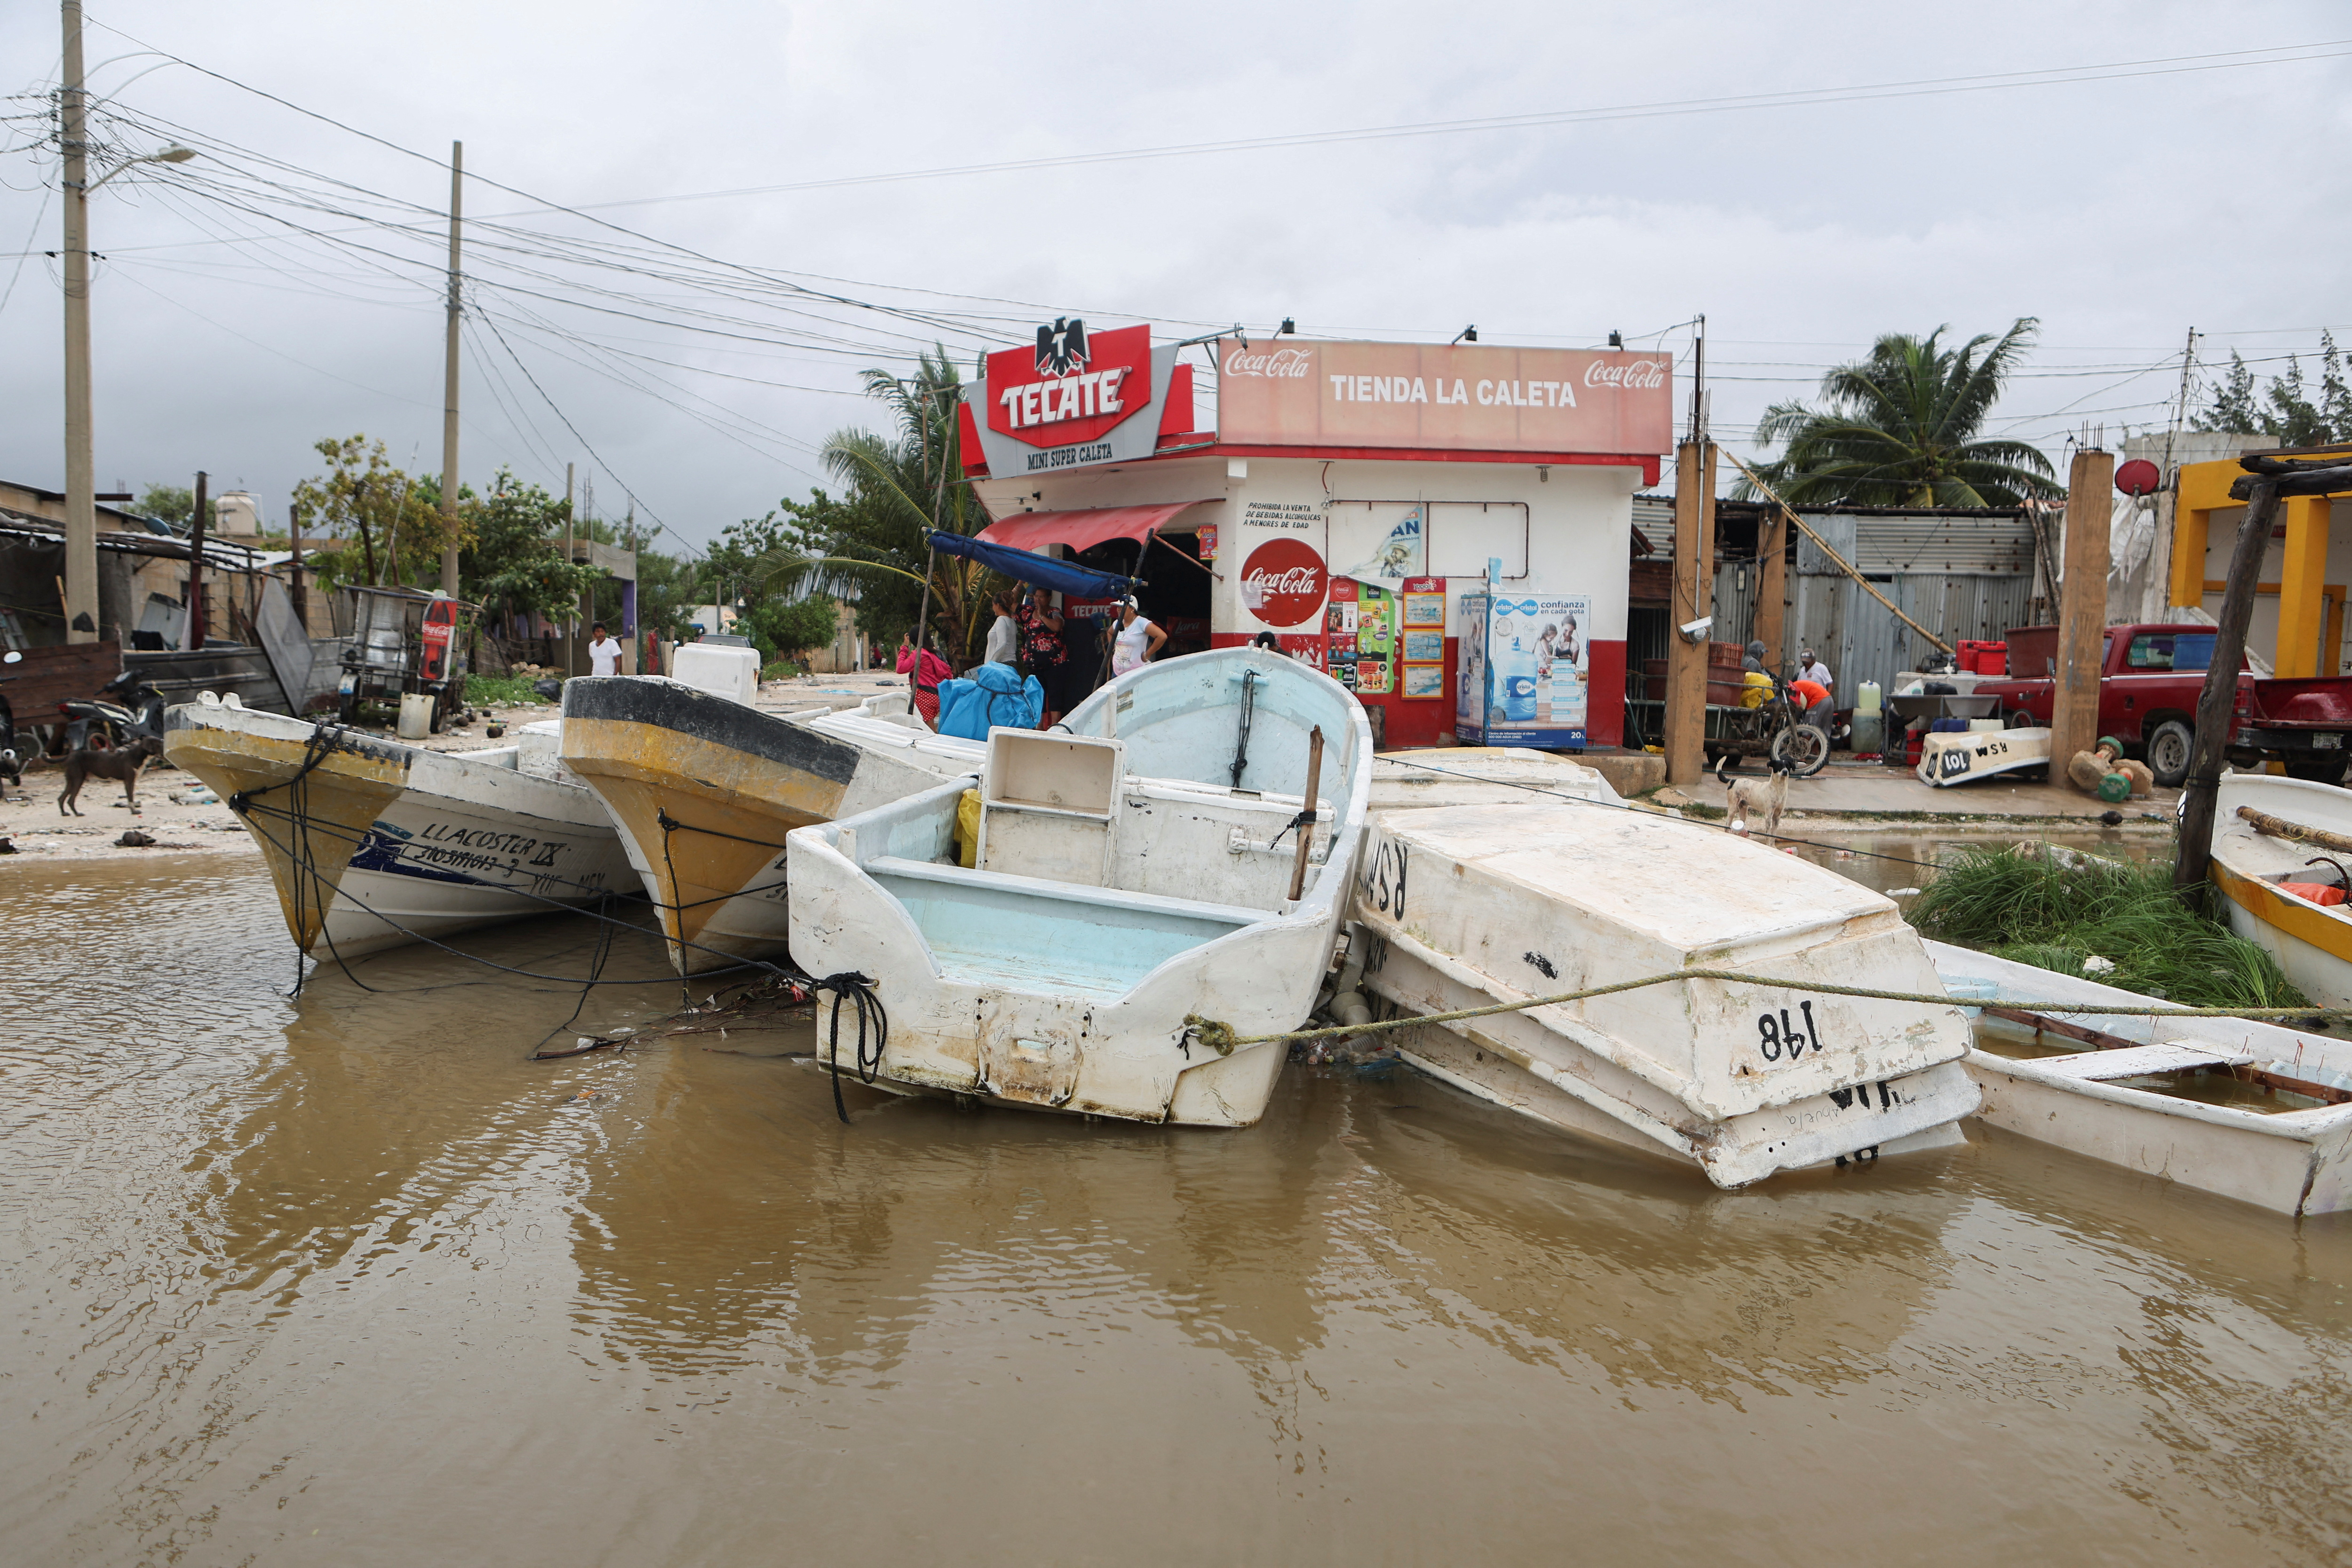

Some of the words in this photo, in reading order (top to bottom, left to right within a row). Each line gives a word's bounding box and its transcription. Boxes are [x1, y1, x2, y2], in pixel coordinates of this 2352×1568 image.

[1000, 368, 1122, 428] TECATE
[1330, 375, 1428, 402] TIENDA
[1436, 378, 1469, 404] LA
[1476, 379, 1577, 407] CALETA
[1027, 451, 1048, 470] MINI
[1051, 447, 1076, 467] SUPER
[1079, 443, 1112, 462] CALETA
[1248, 502, 1281, 511] PROHIBIDA
[1285, 513, 1321, 521] ALCOHOLICAS
[1249, 519, 1279, 528] MENORES
[1247, 567, 1319, 594] Coca-Cola
[1072, 605, 1112, 617] TECATE
[1945, 752, 1966, 771] 101
[1976, 742, 2008, 757] RSM
[1758, 1000, 1823, 1062] 148
